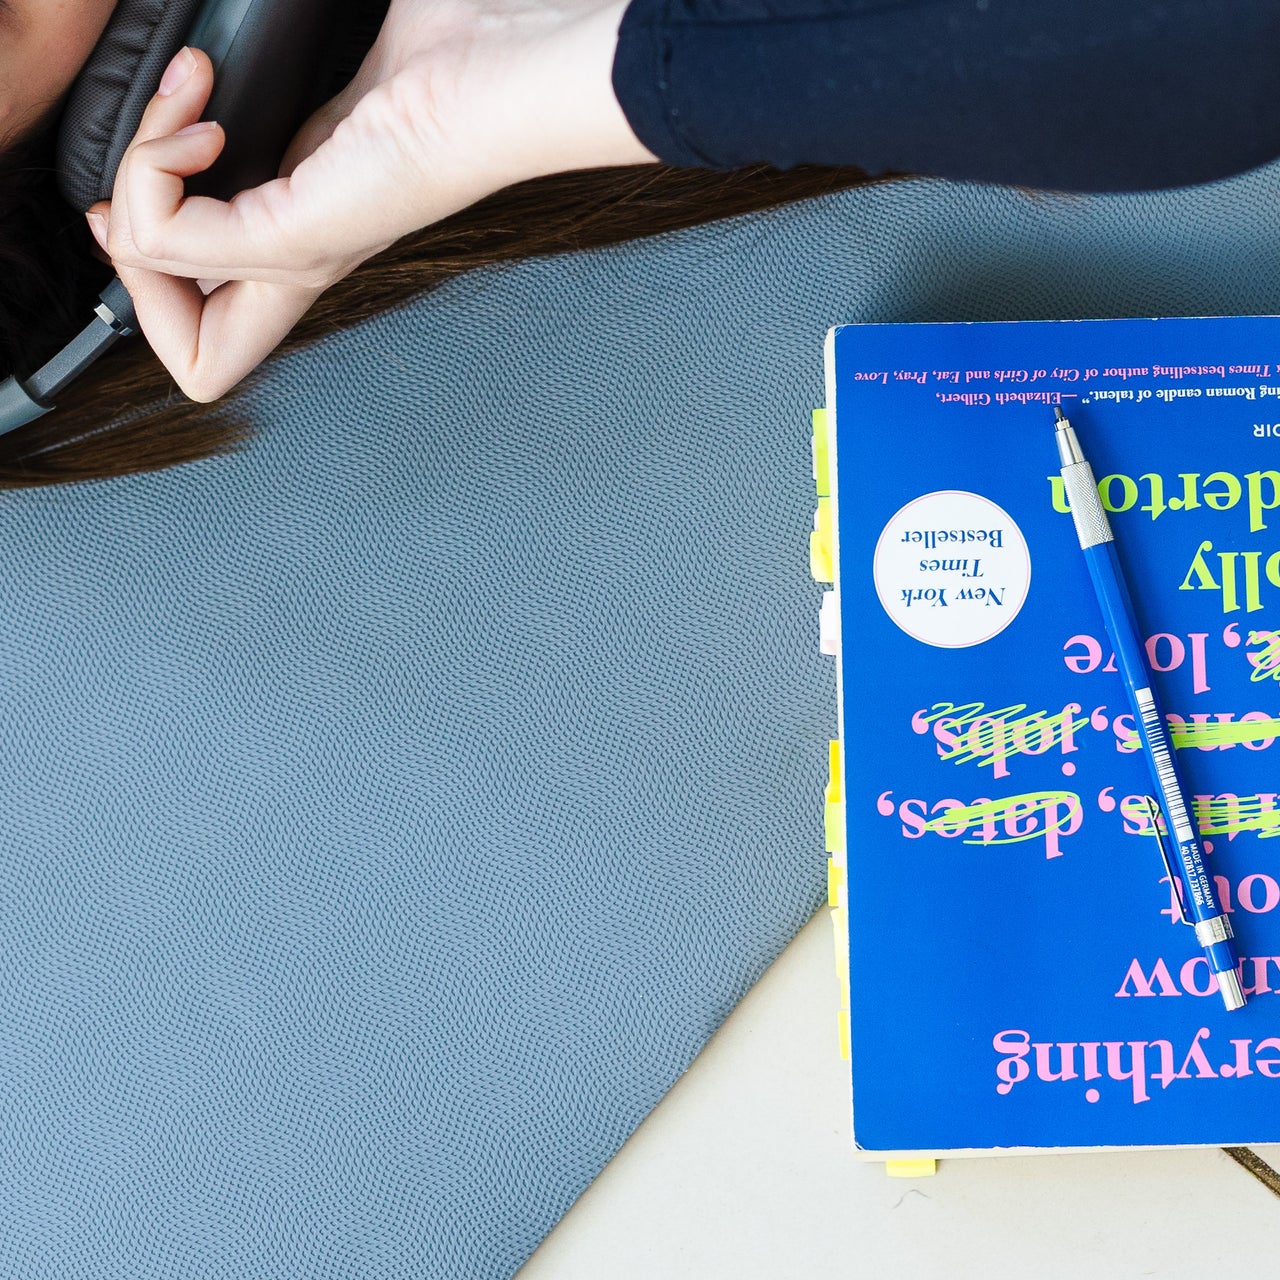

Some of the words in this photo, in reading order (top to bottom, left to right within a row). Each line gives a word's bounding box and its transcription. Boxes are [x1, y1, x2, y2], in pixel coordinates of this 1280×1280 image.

[854, 371, 888, 385] Love
[893, 369, 928, 384] Pray,
[932, 369, 960, 384] Eat,
[965, 370, 991, 383] and
[994, 369, 1029, 383] Girls
[1030, 367, 1047, 383] of
[1051, 367, 1080, 382] City
[1083, 368, 1098, 380] of
[1102, 367, 1149, 380] author
[1152, 365, 1225, 379] bestselling
[1229, 365, 1271, 378] Times
[935, 391, 991, 406] Gilbert,
[1136, 390, 1152, 403] of
[1156, 389, 1202, 402] candle
[1206, 387, 1256, 400] Roman
[901, 529, 1004, 549] Bestseller
[919, 559, 984, 578] Times
[900, 588, 948, 607] York
[955, 587, 1006, 607] New
[910, 702, 1082, 779] jobs,
[877, 790, 1084, 860] dates,
[1190, 843, 1202, 864] MADE
[1195, 865, 1204, 874] IN
[1198, 874, 1215, 909] GERMANY
